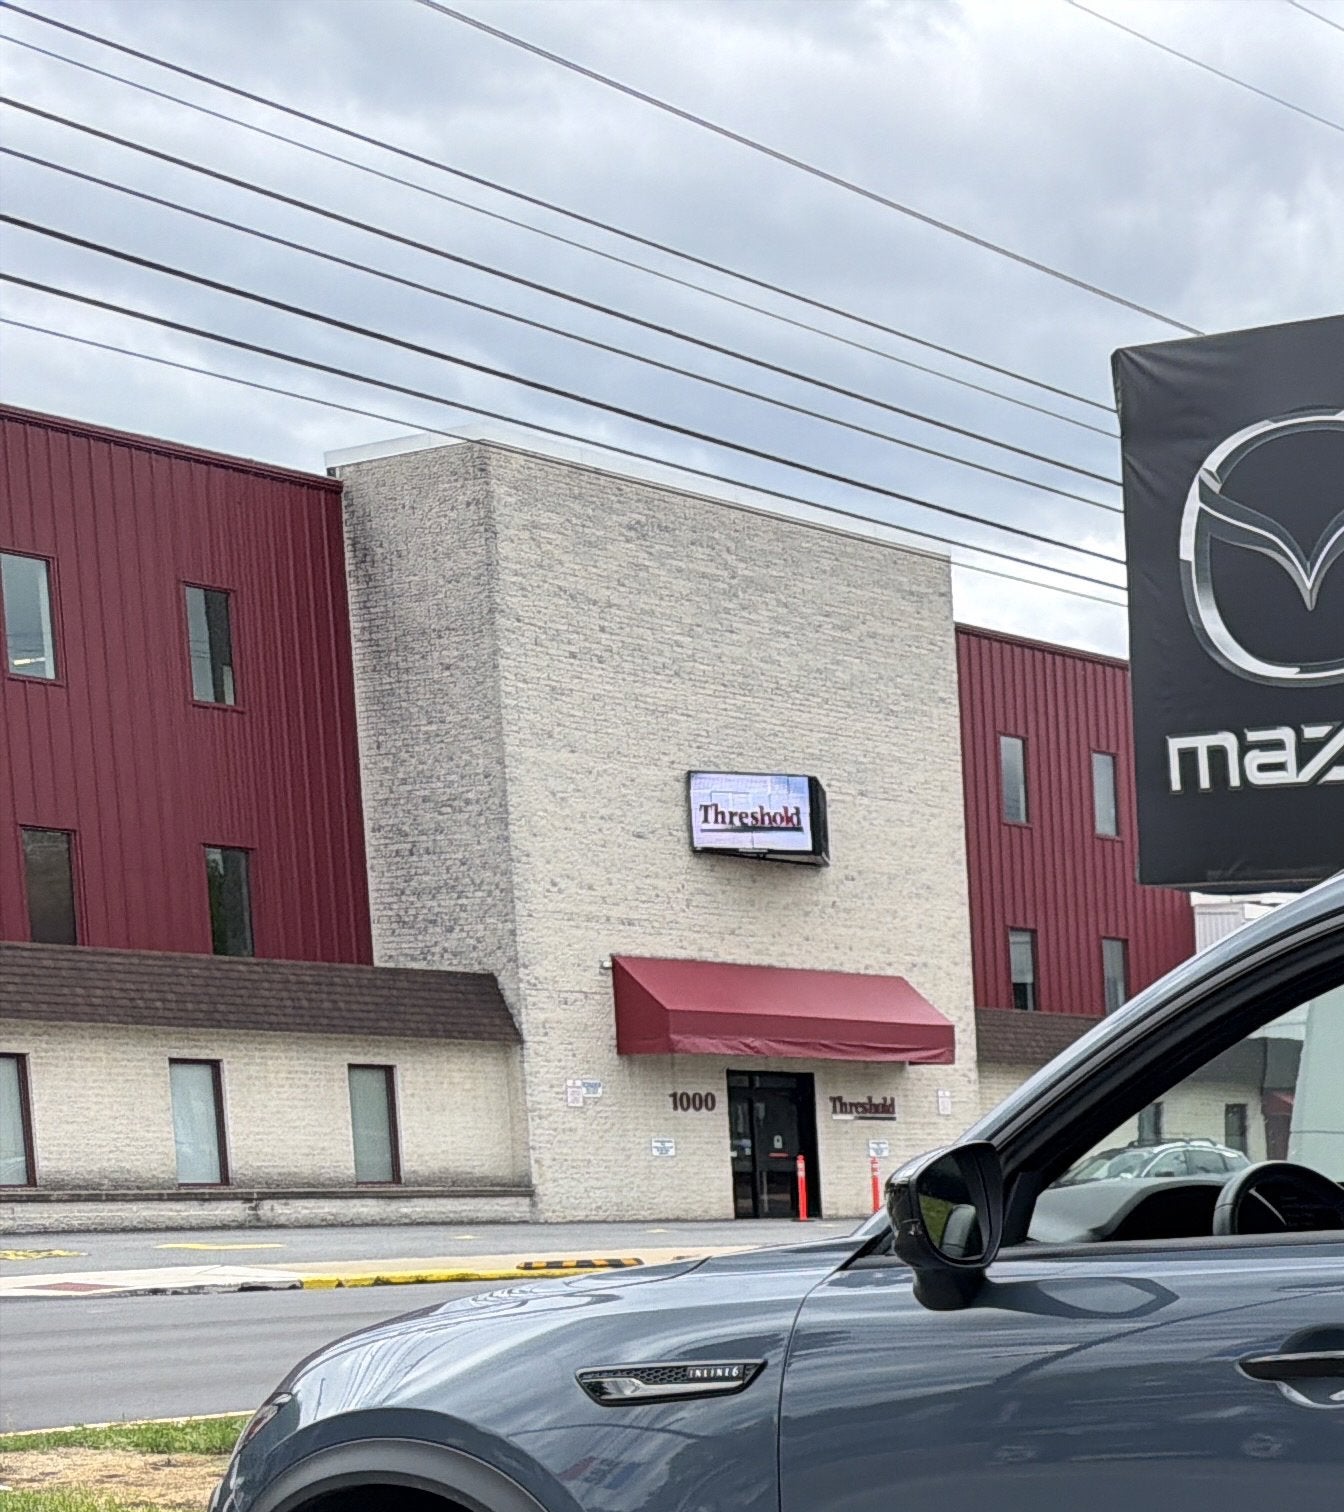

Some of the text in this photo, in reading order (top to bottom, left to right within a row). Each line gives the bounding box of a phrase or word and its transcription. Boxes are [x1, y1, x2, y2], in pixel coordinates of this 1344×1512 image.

[699, 803, 802, 827] Threshold
[668, 1091, 717, 1112] 1000
[829, 1095, 897, 1116] Threshold
